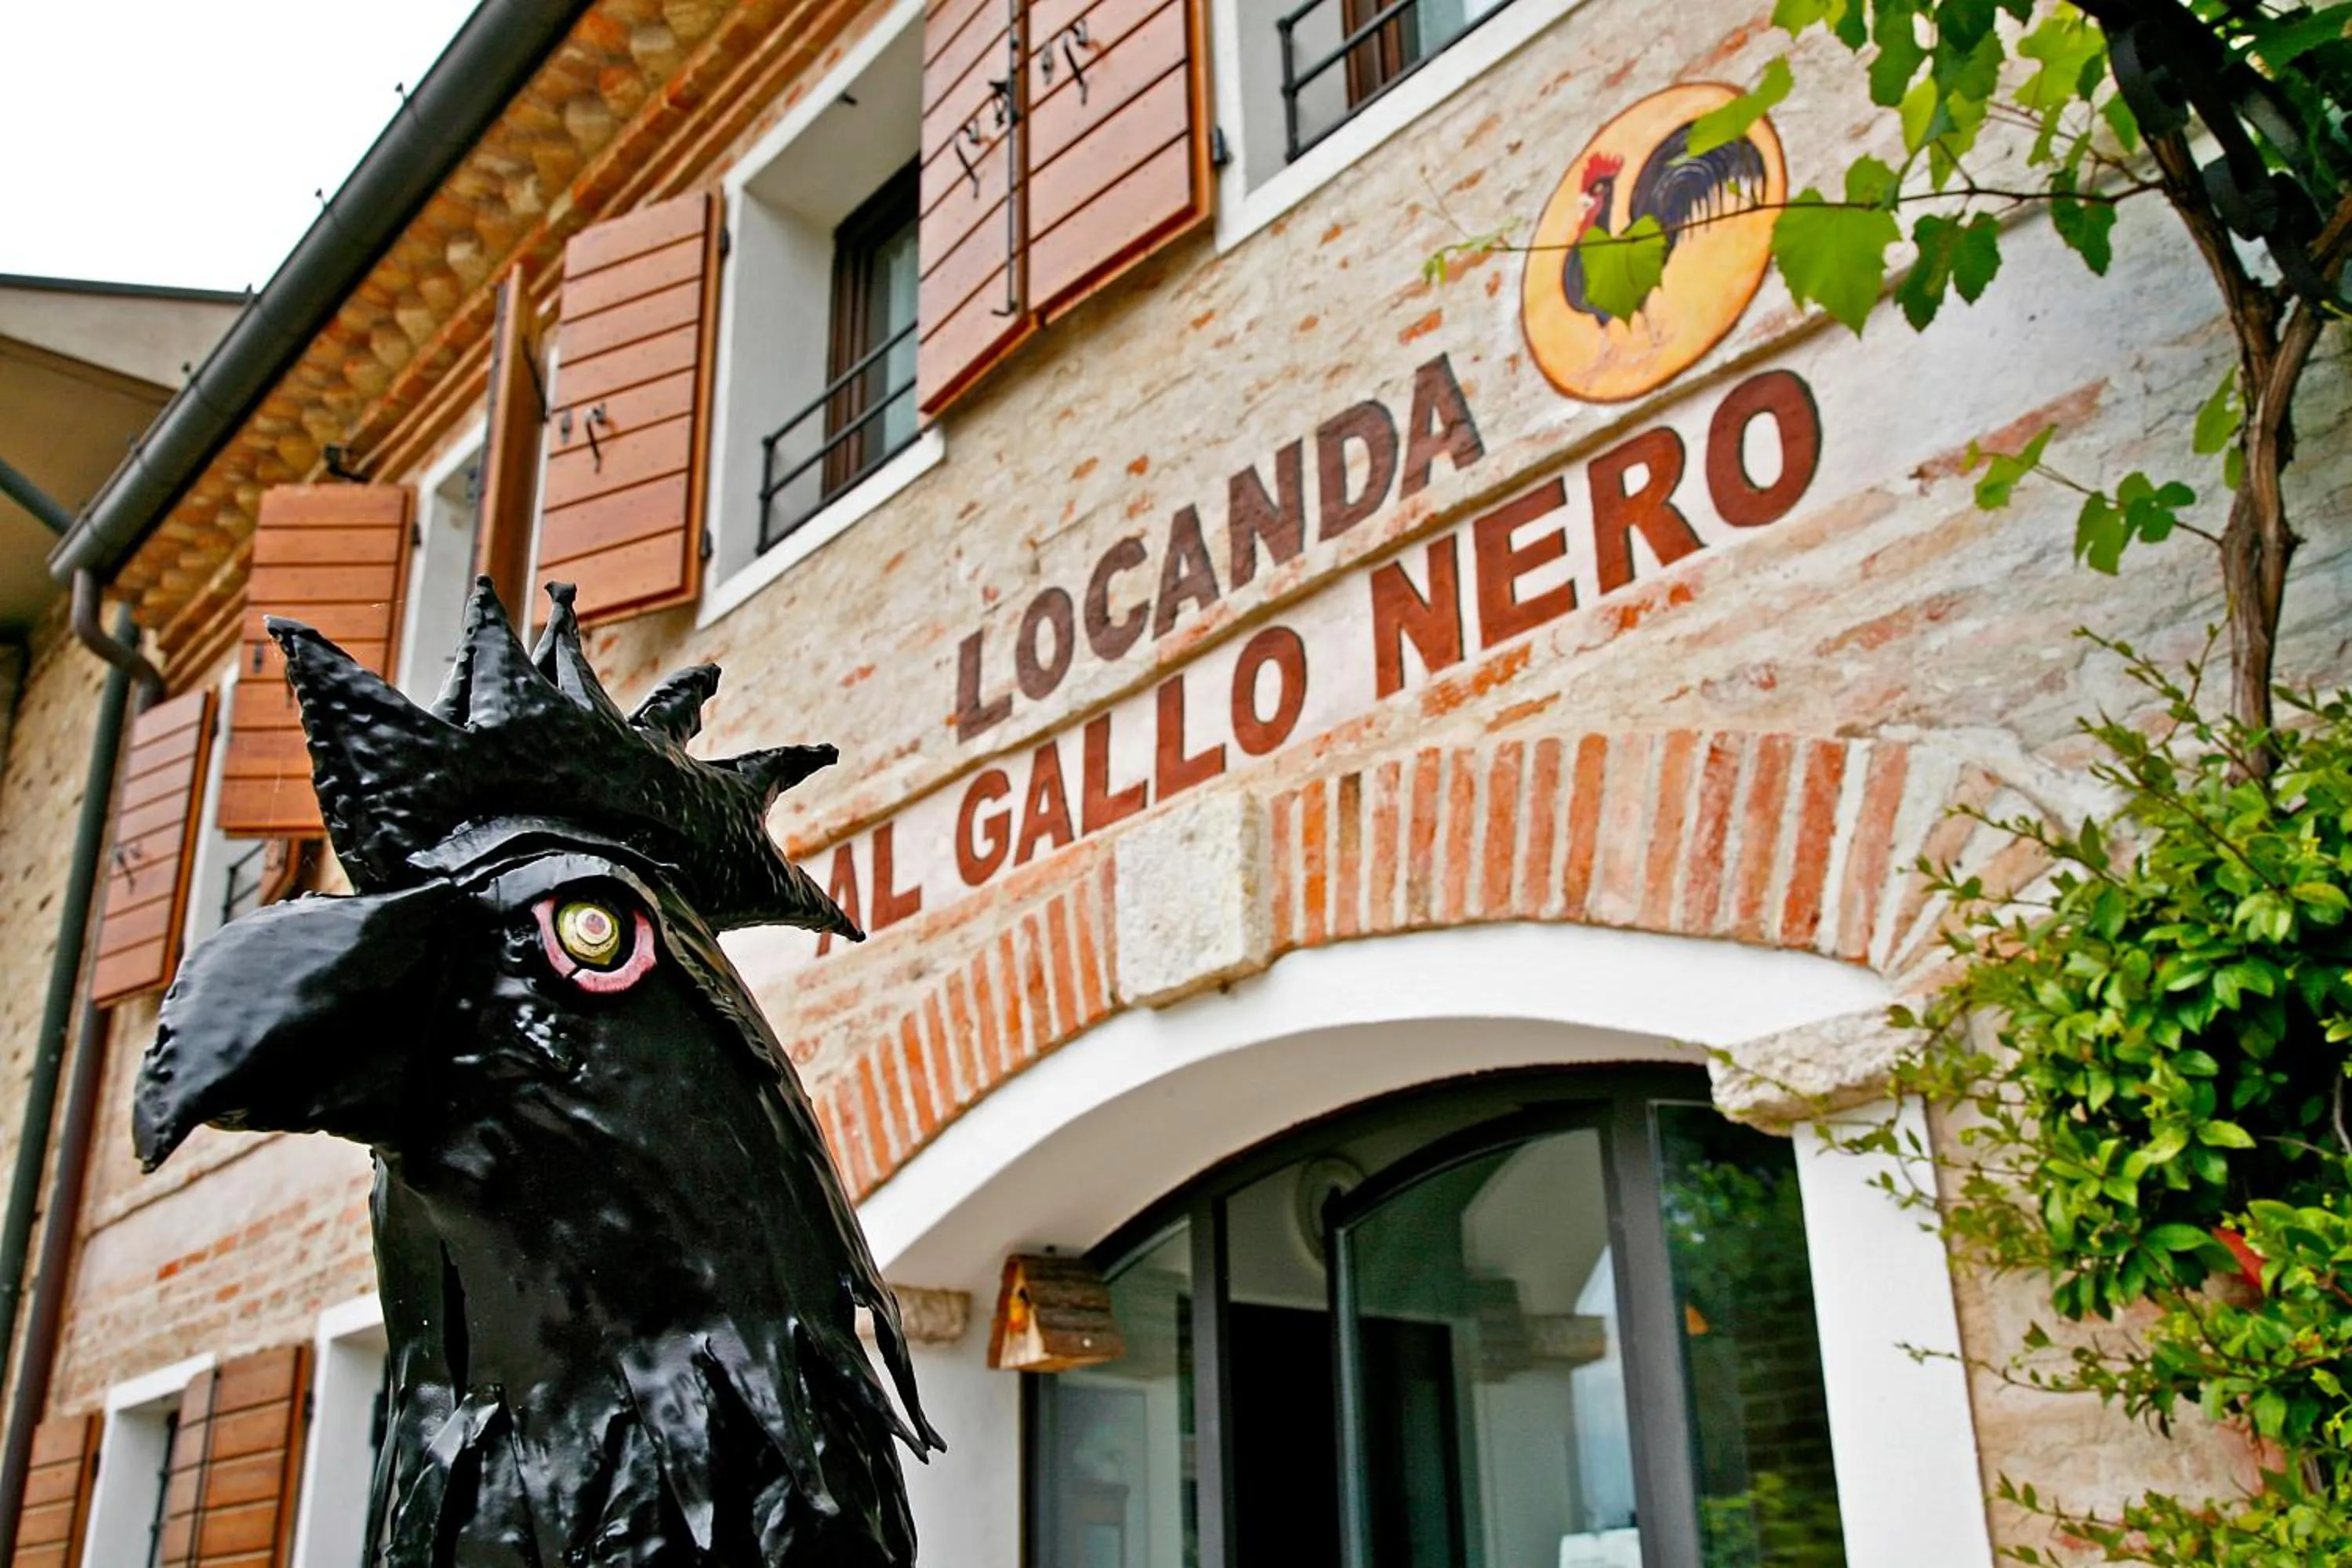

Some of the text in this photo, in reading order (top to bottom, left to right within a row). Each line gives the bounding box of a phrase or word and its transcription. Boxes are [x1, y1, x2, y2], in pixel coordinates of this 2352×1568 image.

[816, 369, 1822, 957] AL GALLO NERO
[956, 352, 1484, 742] LOCANDA
